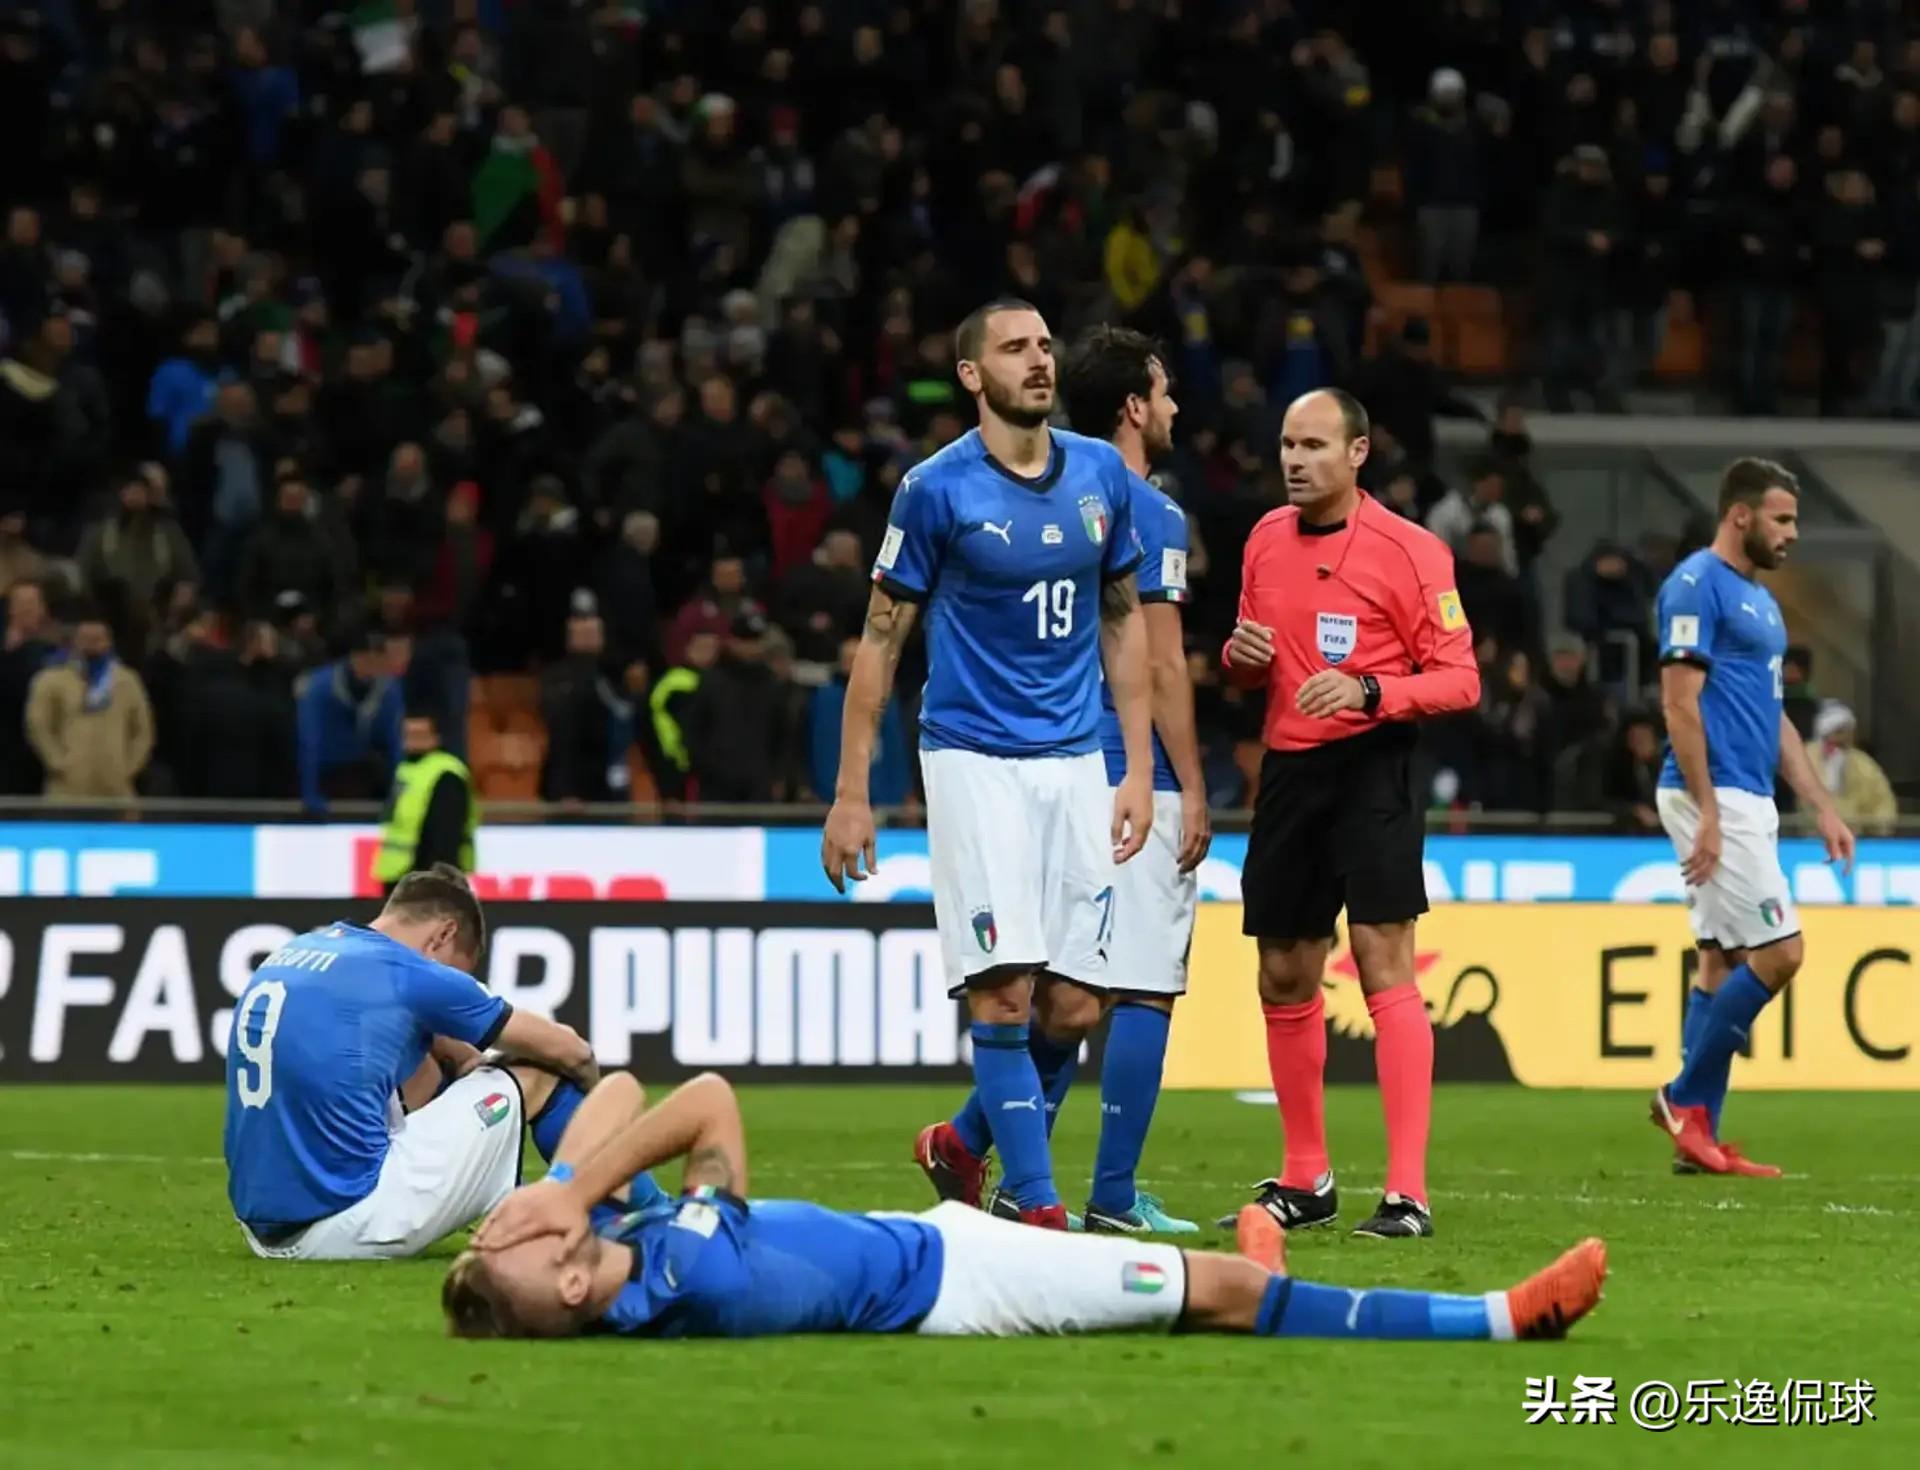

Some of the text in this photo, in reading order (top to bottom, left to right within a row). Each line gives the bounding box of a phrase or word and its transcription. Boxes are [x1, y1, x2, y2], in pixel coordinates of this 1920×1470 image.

[1022, 578, 1077, 640] 19
[1323, 633, 1348, 645] FIFA
[236, 979, 287, 1110] 9
[590, 927, 958, 1066] PUMA
